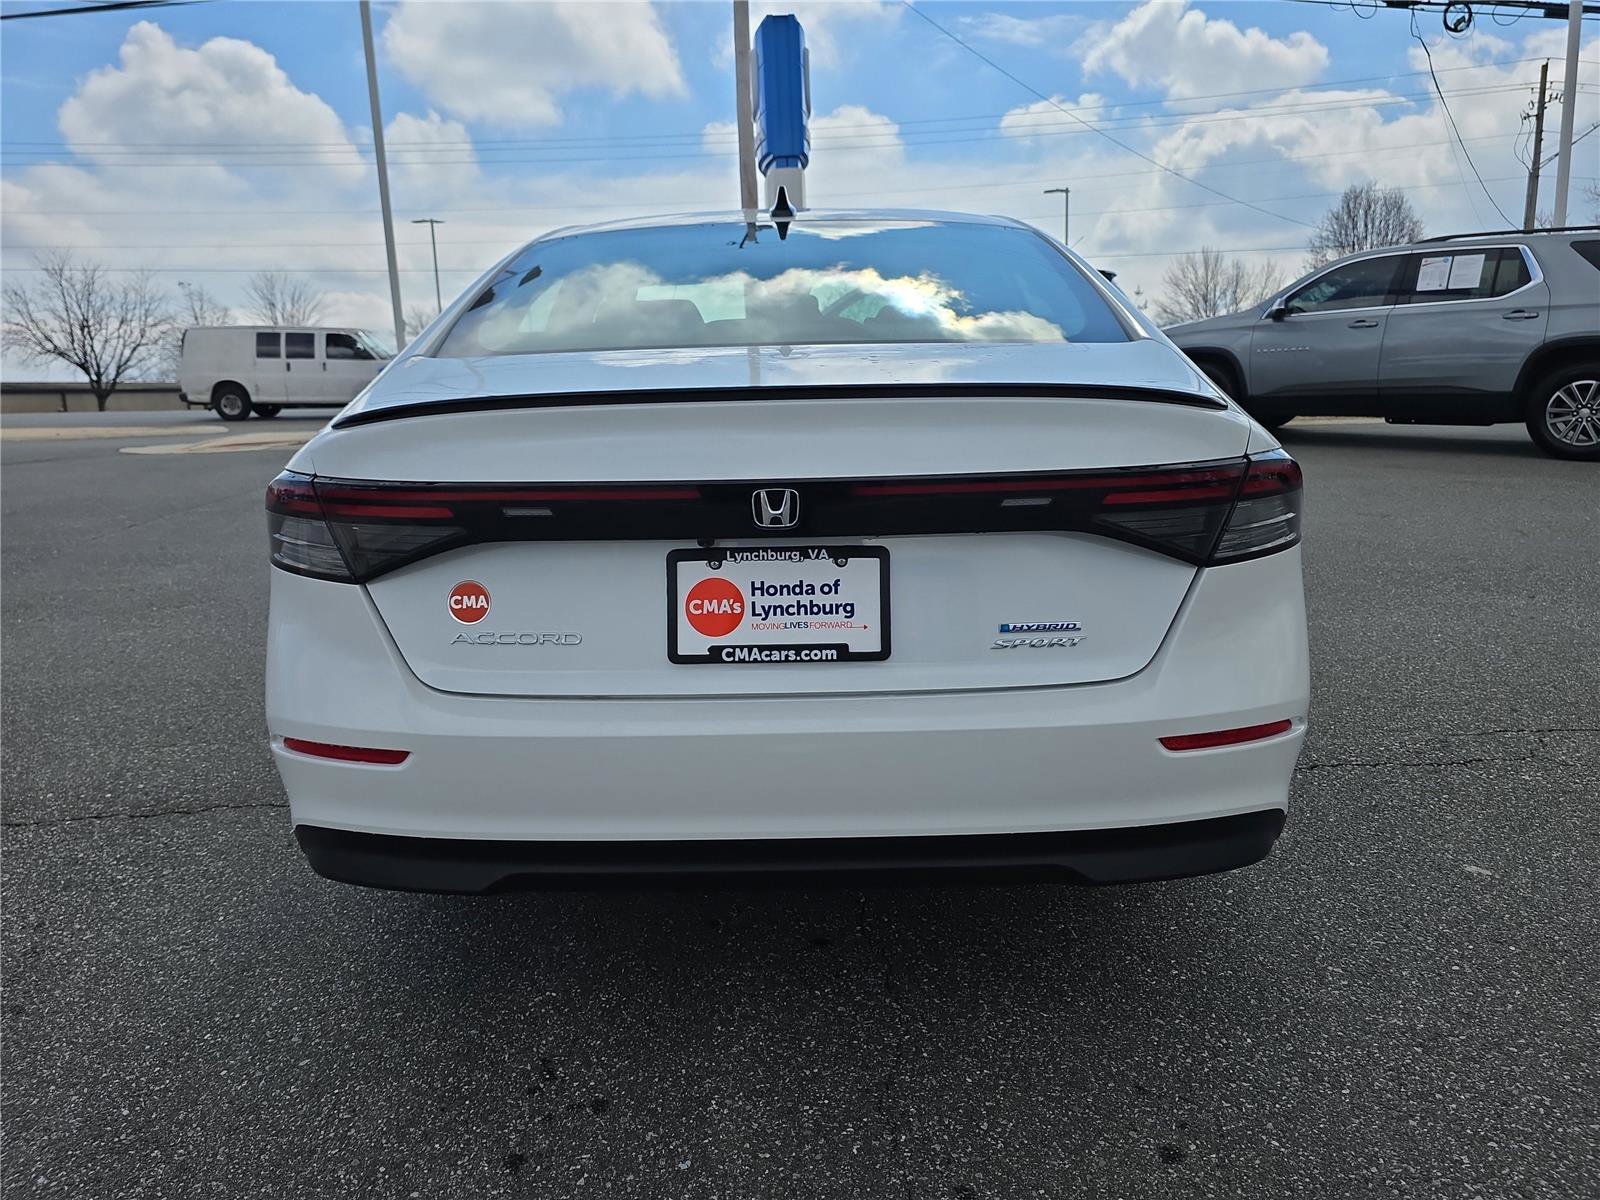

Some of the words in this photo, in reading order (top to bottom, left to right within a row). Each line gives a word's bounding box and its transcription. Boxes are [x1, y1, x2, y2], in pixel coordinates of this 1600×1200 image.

[726, 549, 804, 562] Lynchburg,
[808, 549, 829, 560] VA
[751, 580, 816, 597] Honda
[819, 578, 841, 595] of
[450, 594, 489, 610] CMA
[688, 598, 742, 615] CMA's
[751, 600, 855, 621] Lynchburg
[1011, 622, 1078, 632] HYBRID
[450, 631, 583, 646] ACCORD
[990, 636, 1088, 650] SPORT
[721, 647, 837, 662] CMAcars.com
